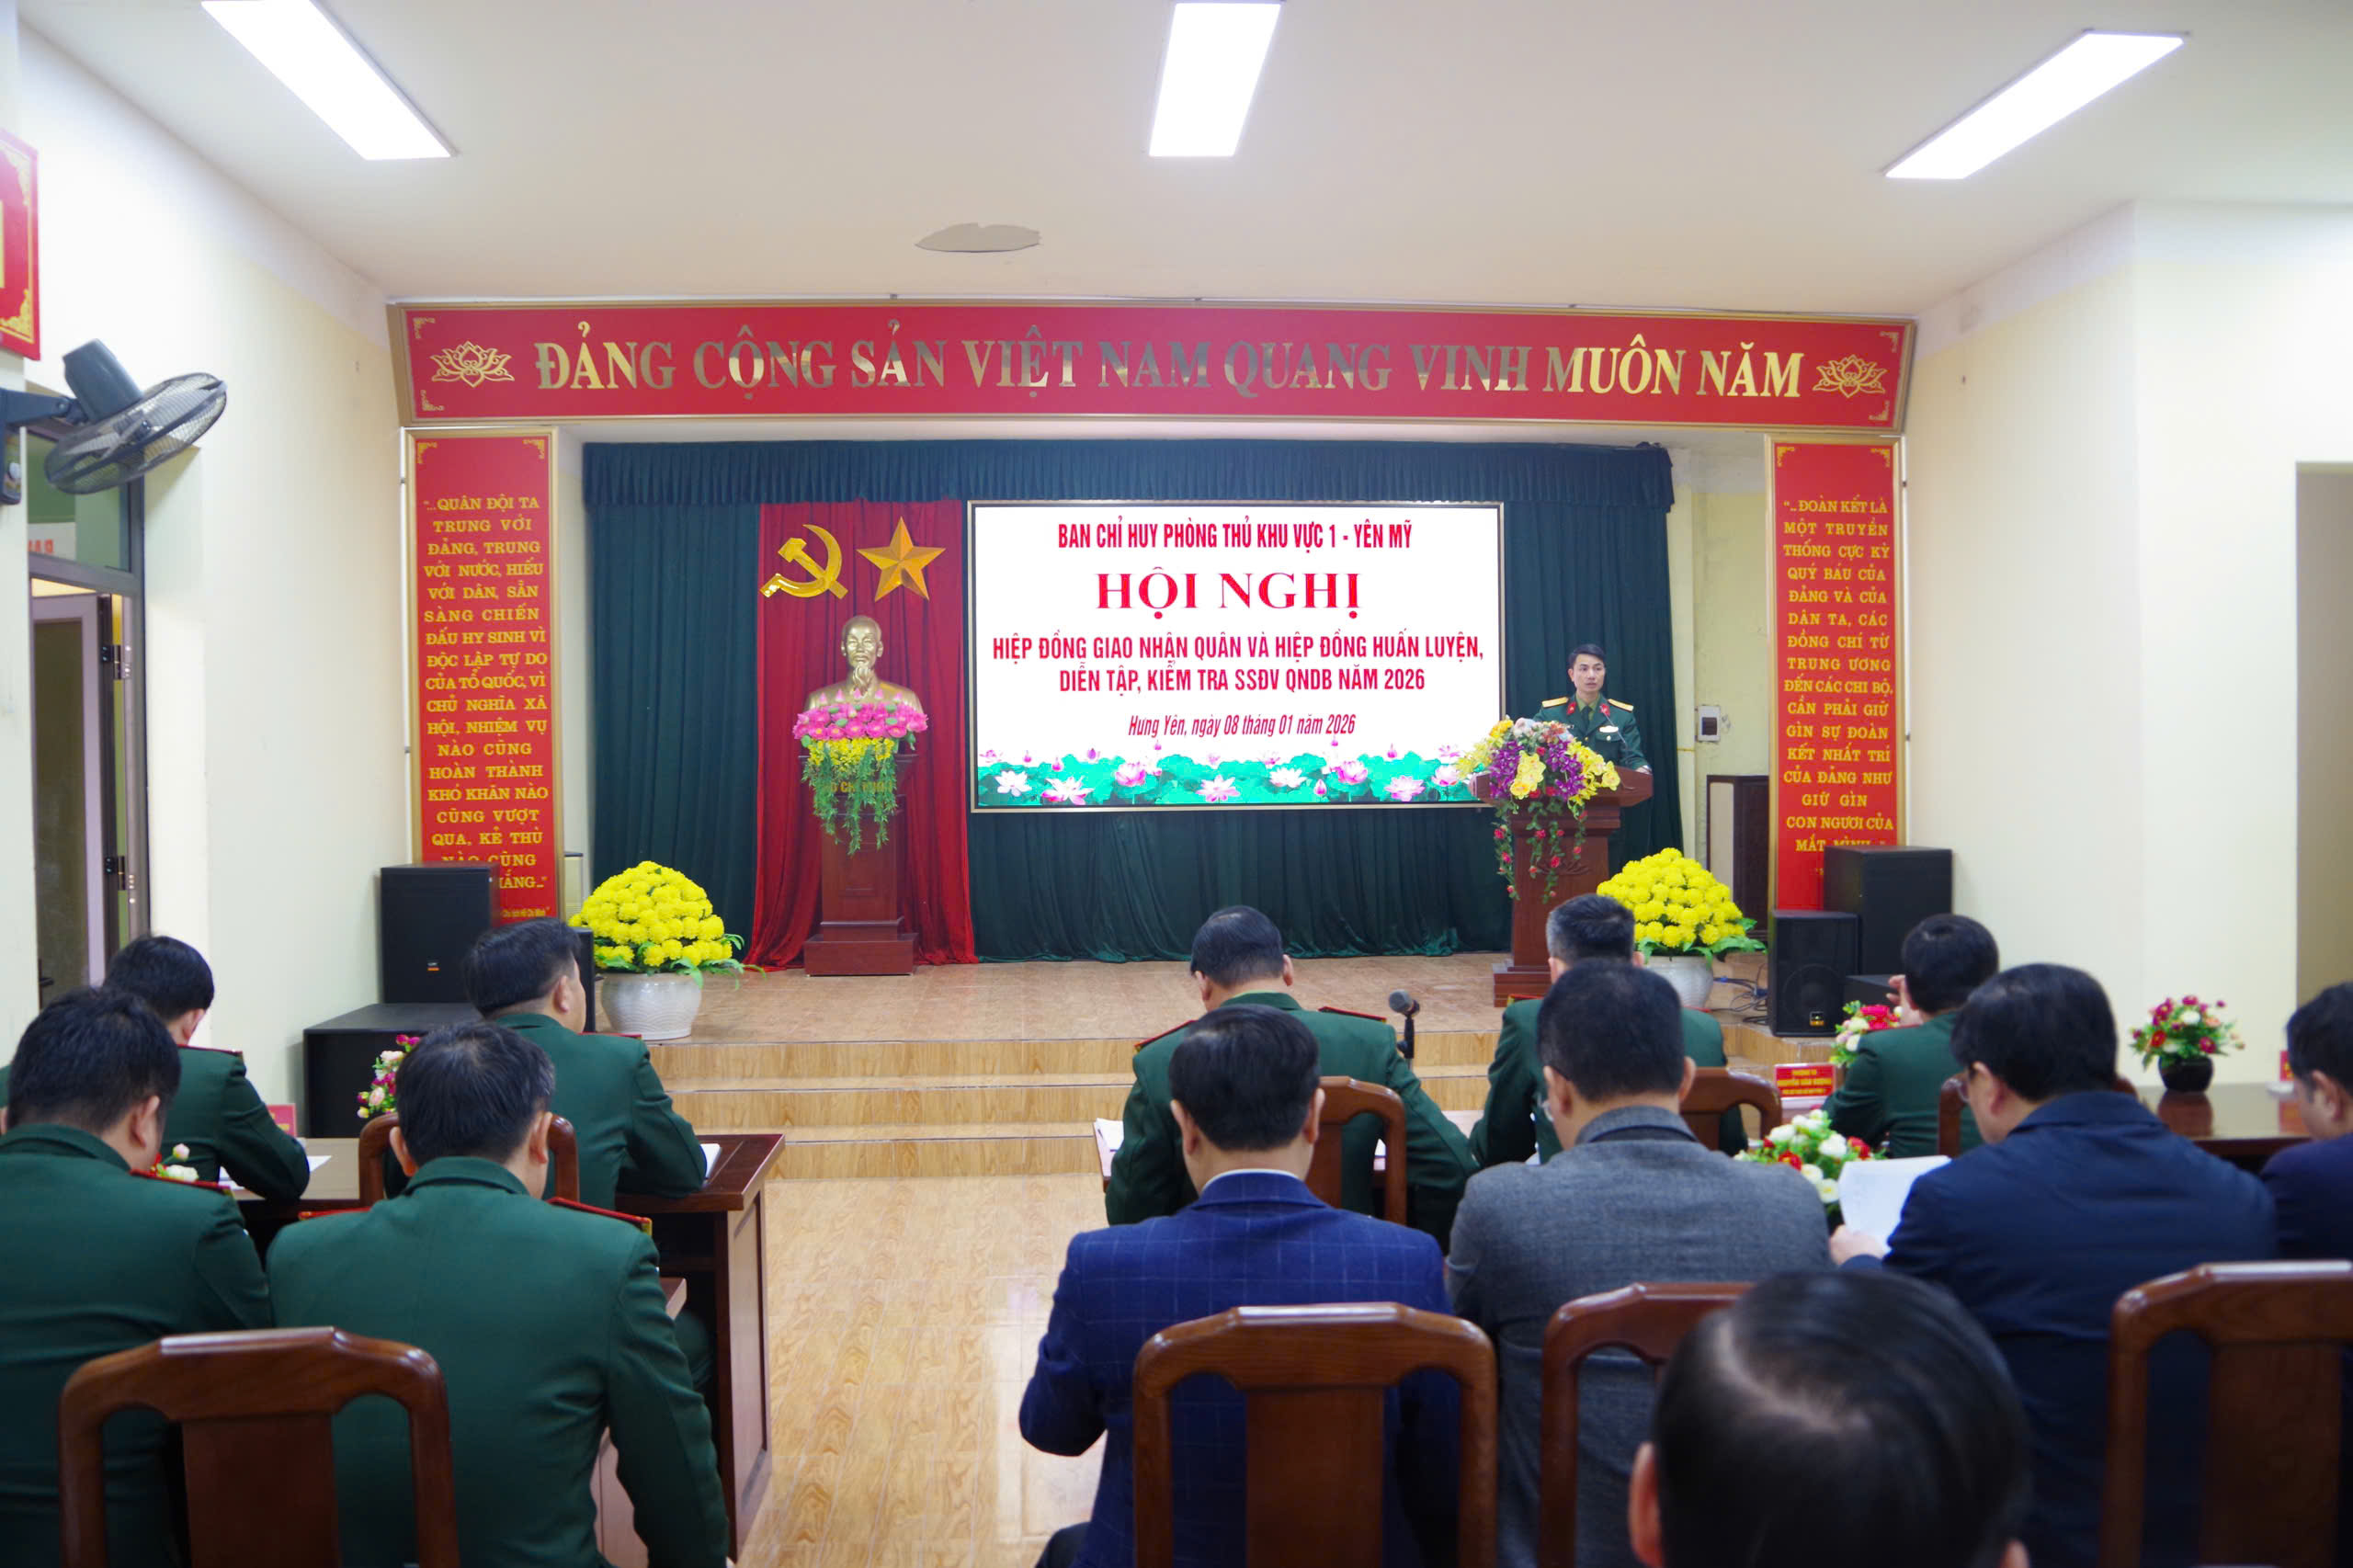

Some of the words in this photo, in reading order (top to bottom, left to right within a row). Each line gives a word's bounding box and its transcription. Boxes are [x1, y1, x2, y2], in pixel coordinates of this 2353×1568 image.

[536, 320, 676, 390] ĐẢNG
[693, 324, 835, 401] CỘNG
[851, 318, 947, 389] SẢN
[964, 324, 1083, 399] VIỆT
[1099, 340, 1211, 387] NAM
[1224, 342, 1392, 399] QUANG
[1411, 344, 1529, 392] VINH
[1546, 333, 1687, 397] MUÔN
[1697, 340, 1804, 399] NĂM
[487, 494, 514, 512] ĐỘI
[517, 497, 540, 509] TA
[1841, 494, 1867, 513] KẾT
[1870, 497, 1887, 513] LÀ
[434, 520, 491, 532] TRUNG
[501, 515, 531, 530] VỚI
[1784, 519, 1816, 537] MỘT
[1825, 517, 1888, 536] TRUYỀN
[1058, 523, 1090, 548] BAN
[1097, 516, 1122, 548] CHỈ
[1128, 523, 1158, 548] HUY
[1164, 517, 1217, 548] PHÒNG
[1223, 516, 1251, 548] THỦ
[1257, 523, 1288, 548] KHU
[1294, 521, 1323, 553] VỰC
[1329, 525, 1336, 548] 1
[1354, 518, 1383, 548] YÊN
[1390, 519, 1412, 548] MỸ
[427, 538, 479, 555] ĐẢNG,
[483, 541, 540, 553] TRUNG
[1783, 539, 1831, 557] THỐNG
[1838, 544, 1864, 561] CỰC
[424, 561, 450, 577] VỚI
[459, 560, 502, 577] NƯỚC,
[506, 558, 543, 574] HIẾU
[1788, 563, 1817, 581] QUÝ
[1824, 563, 1851, 580] BÁU
[1858, 563, 1885, 581] CỦA
[427, 583, 455, 600] VỚI
[463, 584, 498, 600] DÂN,
[1097, 566, 1198, 619] HỘI
[1219, 572, 1360, 619] NGHỊ
[1789, 585, 1828, 602] ĐẢNG
[1834, 586, 1852, 602] VÀ
[1859, 586, 1886, 603] CỦA
[425, 607, 473, 622] SÀNG
[483, 603, 540, 620] CHIẾN
[1788, 609, 1820, 625] DÂN
[1828, 613, 1851, 626] TA,
[1859, 611, 1887, 626] CÁC
[426, 627, 457, 645] ĐẤU
[461, 632, 483, 644] HY
[488, 631, 525, 643] SINH
[529, 626, 546, 642] VÌ
[1788, 630, 1829, 648] ĐỒNG
[1838, 632, 1862, 648] CHÍ
[1870, 632, 1889, 648] TỪ
[993, 632, 1031, 665] HIỆP
[1039, 629, 1086, 660] ĐỒNG
[1093, 636, 1132, 660] GIAO
[1140, 631, 1187, 664] NHẬN
[1195, 632, 1241, 660] QUÂN
[1247, 631, 1269, 659] VÀ
[1276, 631, 1313, 665] HIỆP
[1320, 628, 1366, 659] ĐỒNG
[1372, 628, 1419, 659] HUẤN
[1426, 631, 1483, 665] LUYỆN,
[427, 654, 457, 669] ĐỘC
[463, 651, 494, 668] LẬP
[499, 653, 520, 668] TỰ
[525, 653, 547, 665] DO
[1788, 657, 1840, 670] TRUNG
[1849, 658, 1891, 671] ƯƠNG
[426, 672, 456, 689] CỦA
[459, 666, 480, 689] TỔ
[482, 670, 526, 688] QUỐC,
[529, 672, 545, 687] VÌ
[1060, 662, 1101, 692] DIỄN
[1107, 664, 1141, 697] TẬP,
[1148, 660, 1191, 691] KIỂM
[1198, 668, 1228, 690] TRA
[1234, 668, 1279, 690] SSĐV
[1285, 667, 1331, 692] QNDB
[1338, 664, 1379, 689] NĂM
[1384, 667, 1425, 690] 2026
[1784, 673, 1812, 691] ĐẾN
[1815, 676, 1842, 692] CÁC
[1845, 681, 1868, 693] CHI
[426, 694, 457, 711] CHỦ
[466, 695, 515, 710] NGHĨA
[524, 695, 547, 710] XÃ
[1788, 695, 1815, 714] CẦN
[1824, 699, 1857, 716] PHẢI
[427, 719, 460, 737] HỘI,
[466, 717, 517, 736] NHIỆM
[526, 720, 547, 735] VỤ
[1128, 714, 1159, 737] Hưng
[1164, 714, 1188, 737] Yên,
[1191, 715, 1220, 738] ngày
[1224, 714, 1238, 735] 08
[1243, 714, 1275, 737] tháng
[1279, 714, 1293, 734] 01
[1297, 715, 1323, 734] năm
[1326, 714, 1356, 734] 2026
[1787, 722, 1813, 737] GÌN
[1822, 726, 1841, 742] SỰ
[1847, 723, 1888, 739] ĐOÀN
[438, 739, 474, 756] NÀO
[484, 739, 532, 755] CŨNG
[1788, 743, 1815, 760] KẾT
[1824, 743, 1860, 761] NHẤT
[1868, 747, 1890, 762] TRÍ
[429, 762, 475, 778] HOÀN
[485, 760, 543, 777] THÀNH
[1784, 765, 1811, 783] CỦA
[1817, 765, 1857, 784] ĐẢNG
[1863, 772, 1893, 785] NHƯ
[427, 783, 461, 801] KHÓ
[515, 782, 548, 799] NÀO
[1840, 792, 1867, 806] GÌN
[437, 808, 484, 823] CŨNG
[493, 809, 540, 825] VƯỢT
[1787, 816, 1816, 828] CON
[1866, 812, 1893, 830] CỦA
[479, 826, 502, 844] KẺ
[510, 827, 543, 843] THÙ
[1796, 834, 1825, 851] MẮT
